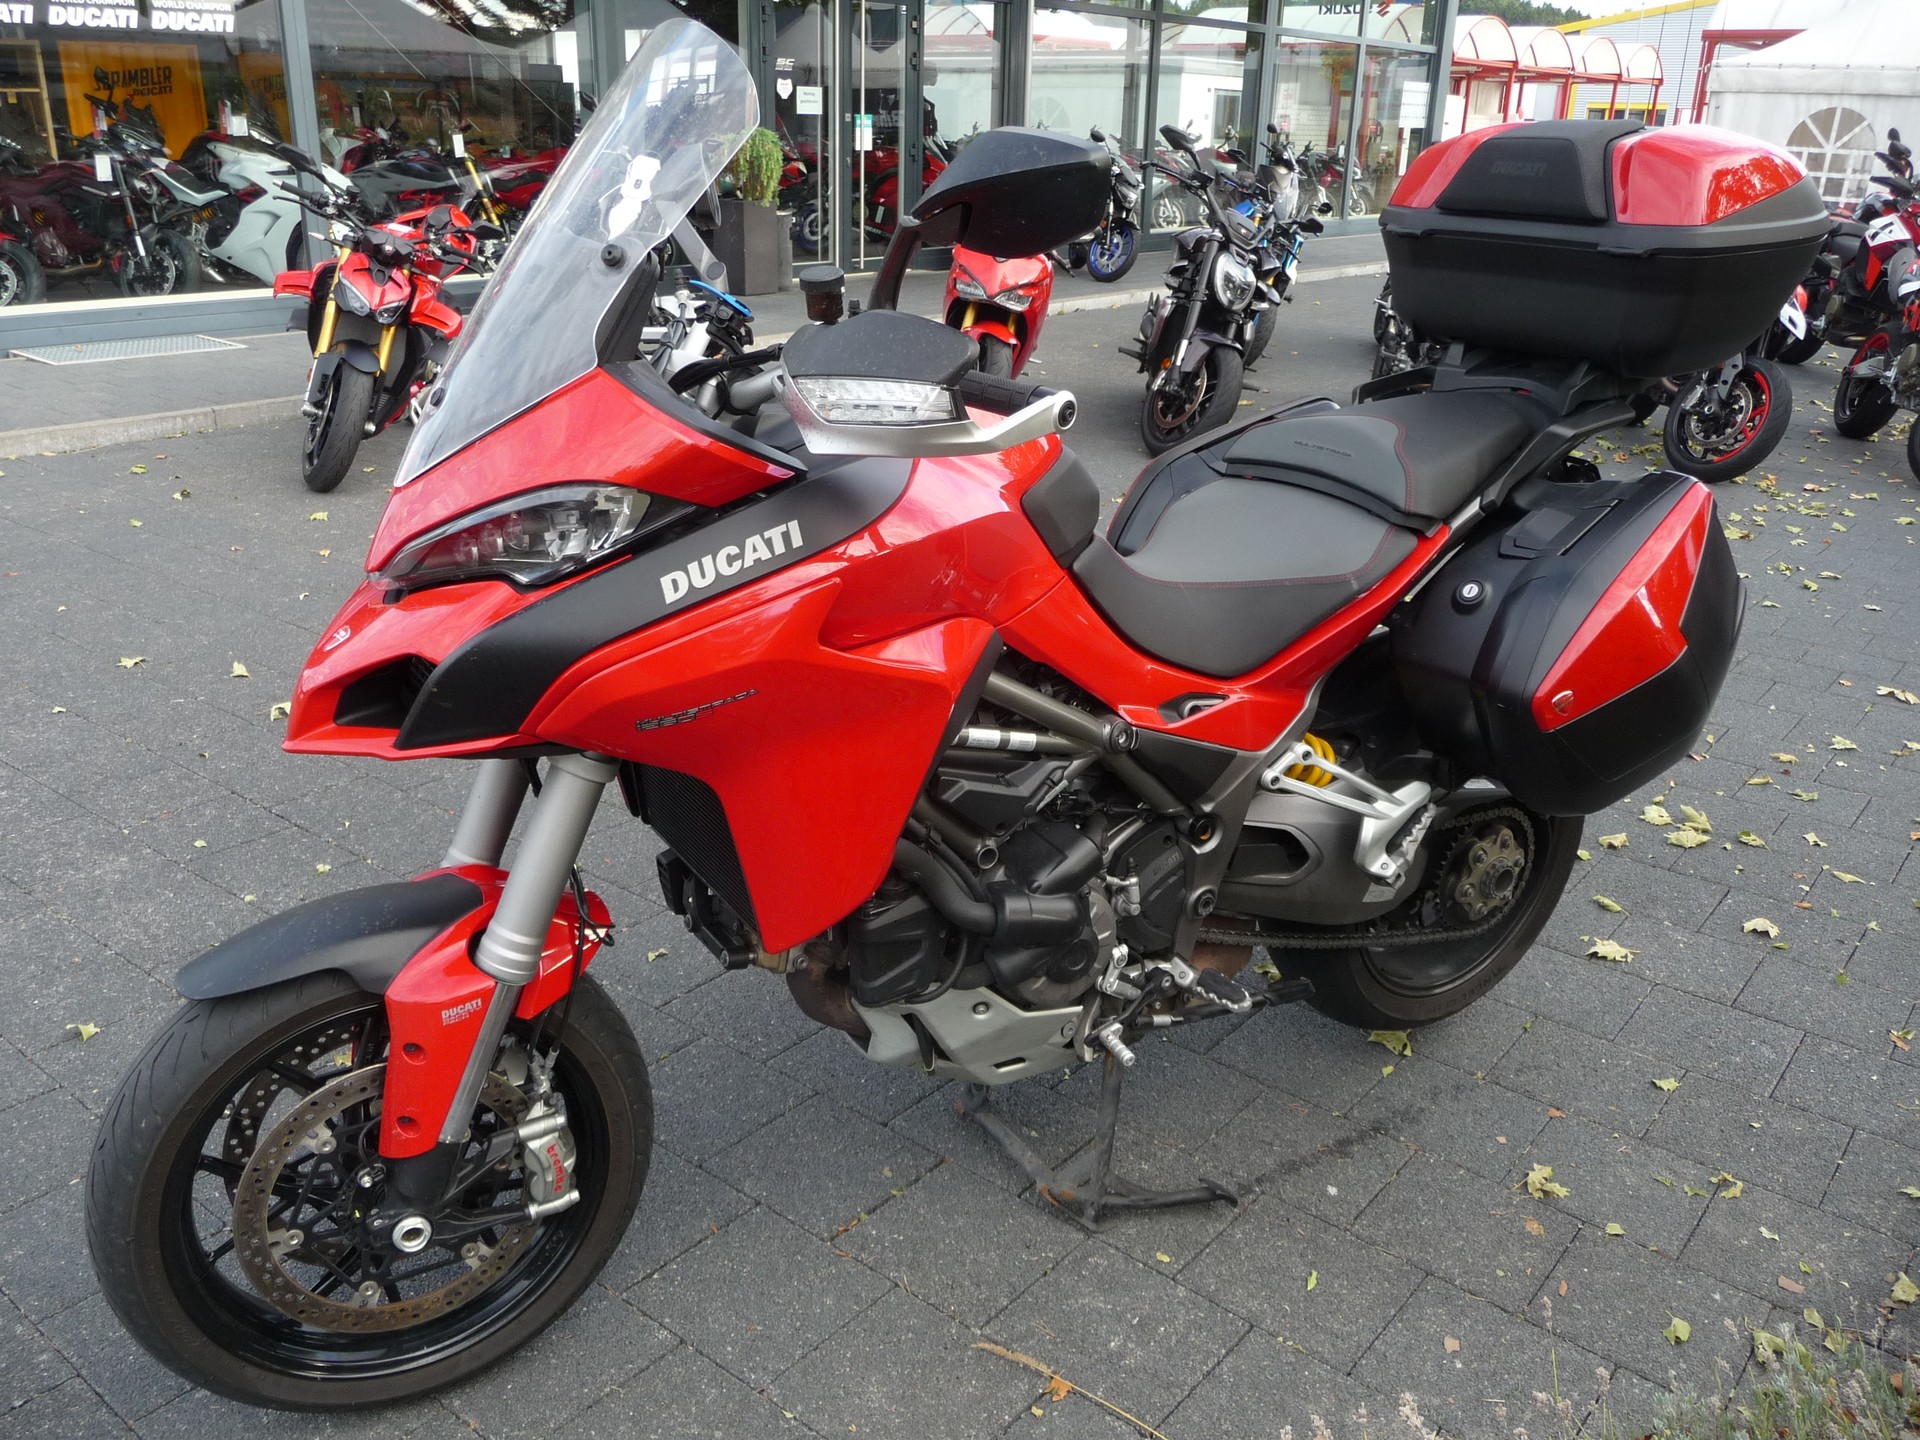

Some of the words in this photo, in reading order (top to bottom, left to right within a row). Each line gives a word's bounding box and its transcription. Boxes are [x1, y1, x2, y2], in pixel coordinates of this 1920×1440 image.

[48, 5, 139, 29] DUCATI
[153, 0, 185, 9] WORLD
[186, 1, 232, 12] CHAMPION
[151, 10, 235, 33] DUCATI
[94, 65, 172, 91] RAMBLER
[660, 519, 804, 605] DUCATI
[441, 998, 482, 1019] DUCATI
[546, 1143, 563, 1194] brembo
